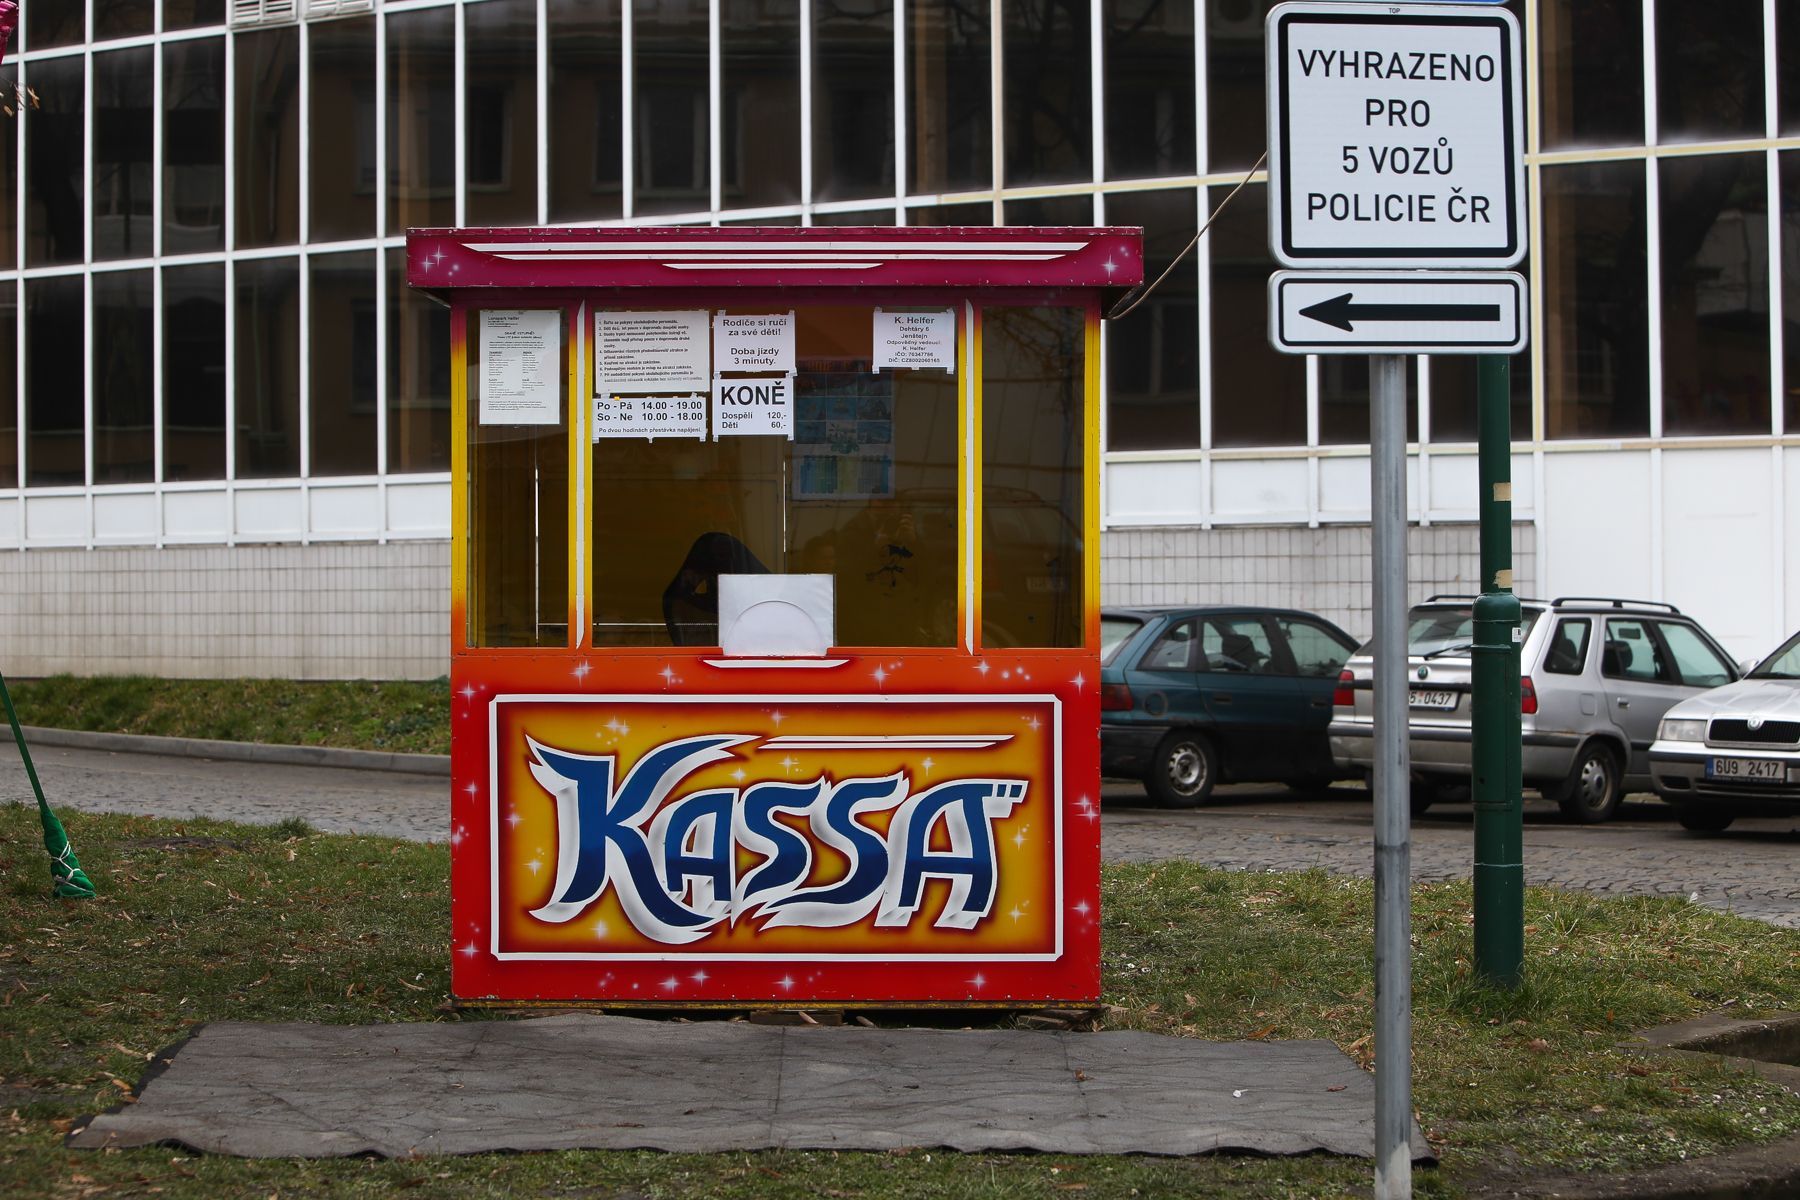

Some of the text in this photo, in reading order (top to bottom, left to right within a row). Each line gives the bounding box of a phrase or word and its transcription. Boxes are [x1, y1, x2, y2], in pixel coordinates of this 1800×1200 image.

[1297, 49, 1495, 82] VYHRAZENO
[1365, 98, 1431, 127] PRO
[1342, 137, 1453, 175] 5 VOZŮ
[1307, 187, 1490, 223] POLICIE ČR
[722, 318, 787, 327] Rodiče si ručí
[894, 316, 904, 324] K.
[728, 328, 781, 336] za své děti!
[730, 347, 780, 357] Doba jízdy
[742, 358, 776, 366] minuty.
[720, 381, 786, 406] KONĚ
[597, 402, 611, 410] Po
[620, 402, 633, 410] Pá
[641, 401, 667, 410] 14.00
[676, 401, 702, 410] 19.00
[597, 413, 611, 421] So
[620, 413, 633, 421] Ne
[642, 412, 668, 421] 10.00
[677, 412, 703, 421] 18.00
[767, 412, 787, 420] 120,-
[770, 422, 787, 430] 60,-
[1424, 692, 1452, 705] 0437
[1716, 760, 1779, 777] 6U9 2417
[525, 734, 1029, 944] KASSA
